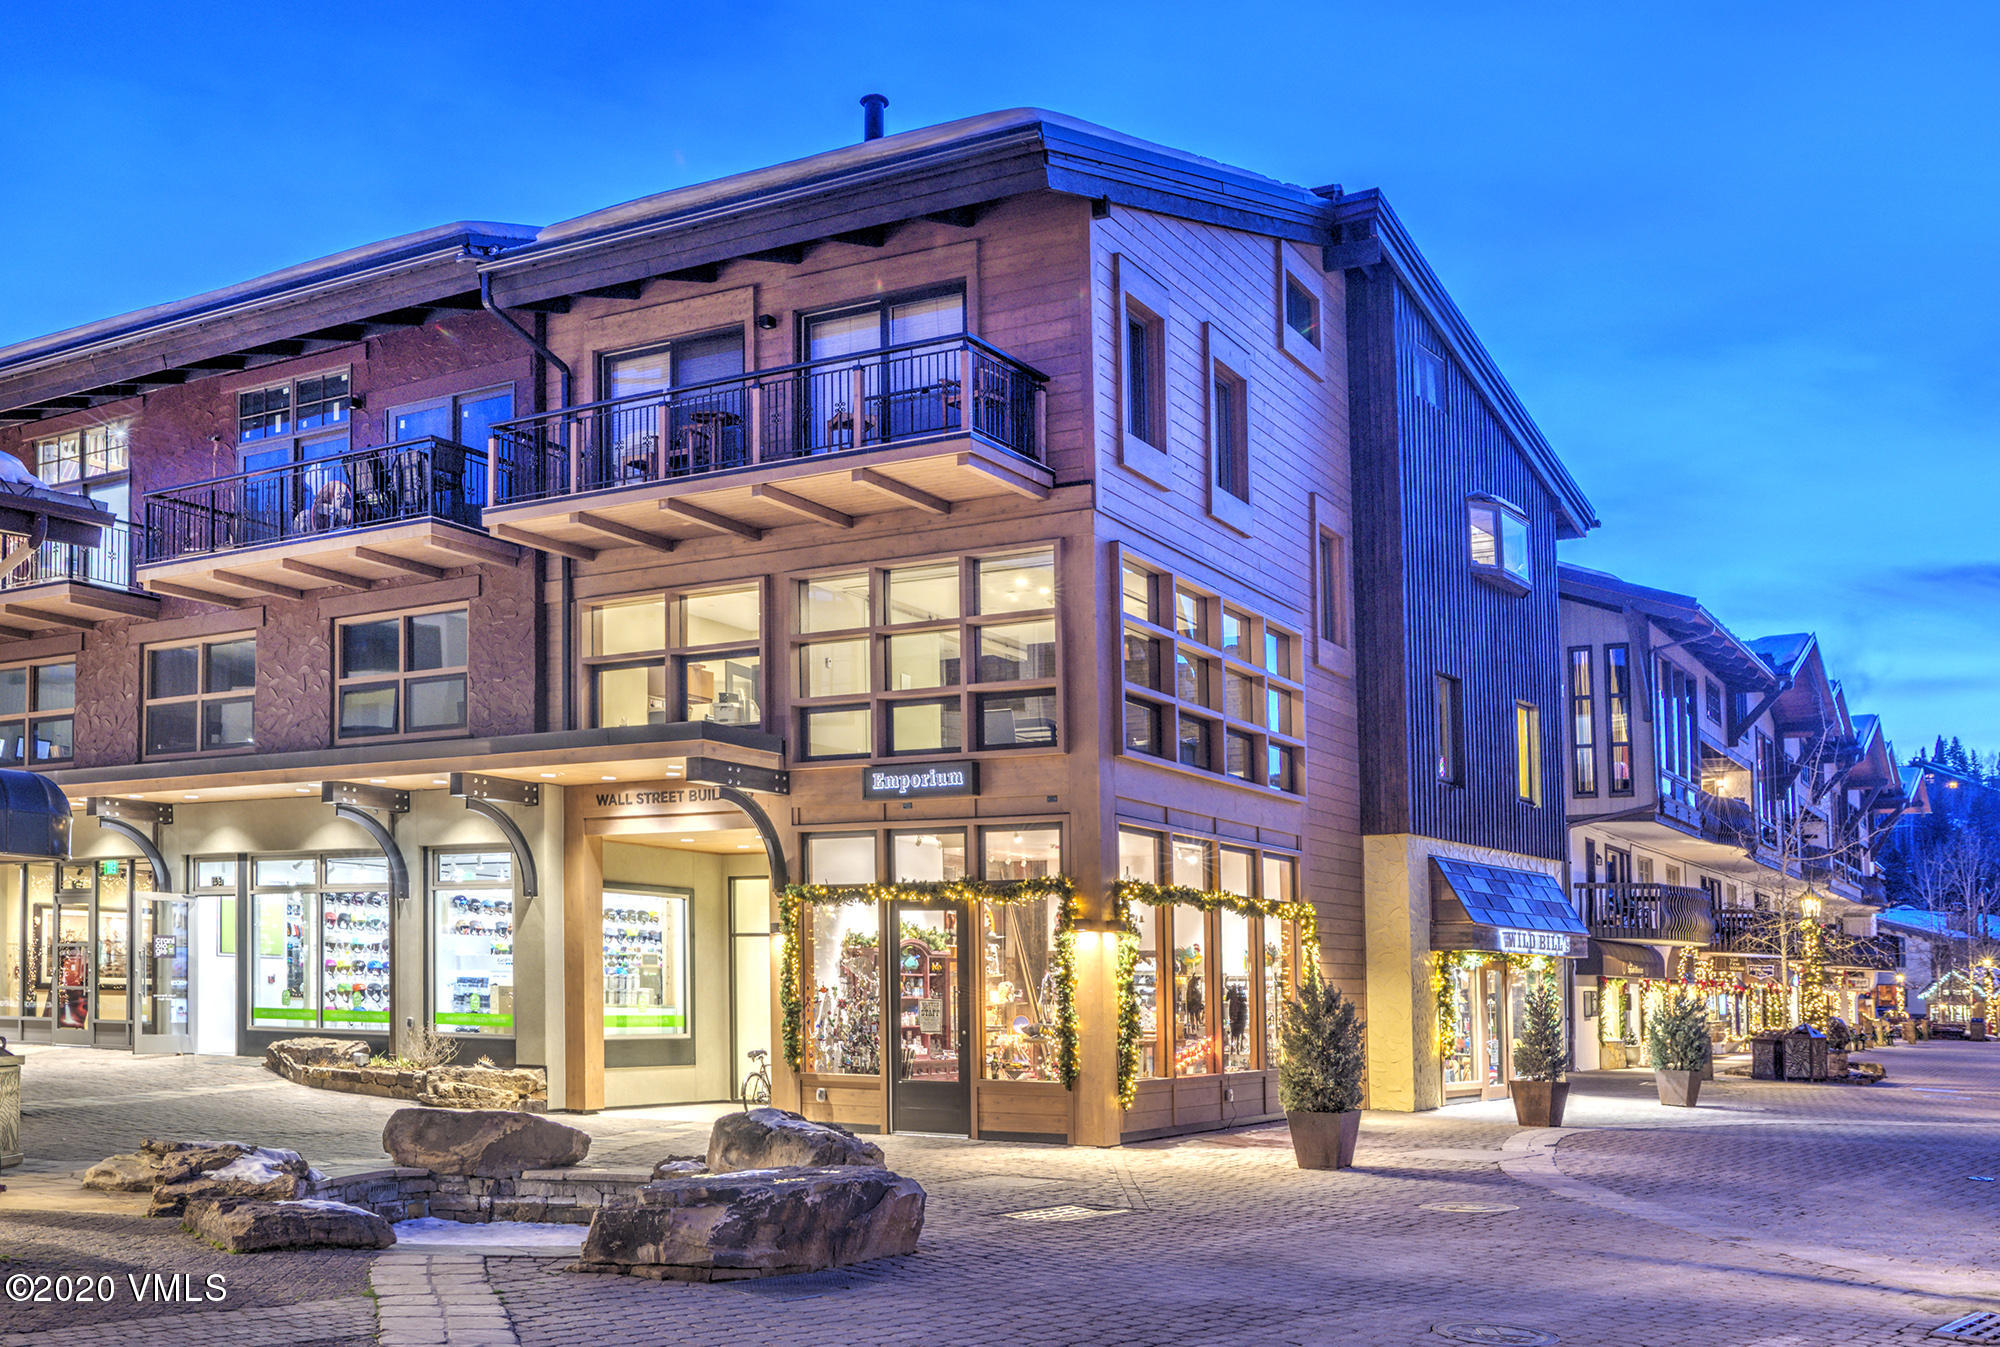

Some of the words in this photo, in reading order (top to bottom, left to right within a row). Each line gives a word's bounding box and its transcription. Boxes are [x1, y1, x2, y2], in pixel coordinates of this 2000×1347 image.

[872, 769, 964, 794] Emporium
[596, 794, 632, 806] WALL
[636, 791, 684, 805] STREET
[689, 786, 720, 802] BUIL
[1502, 931, 1536, 949] WILD
